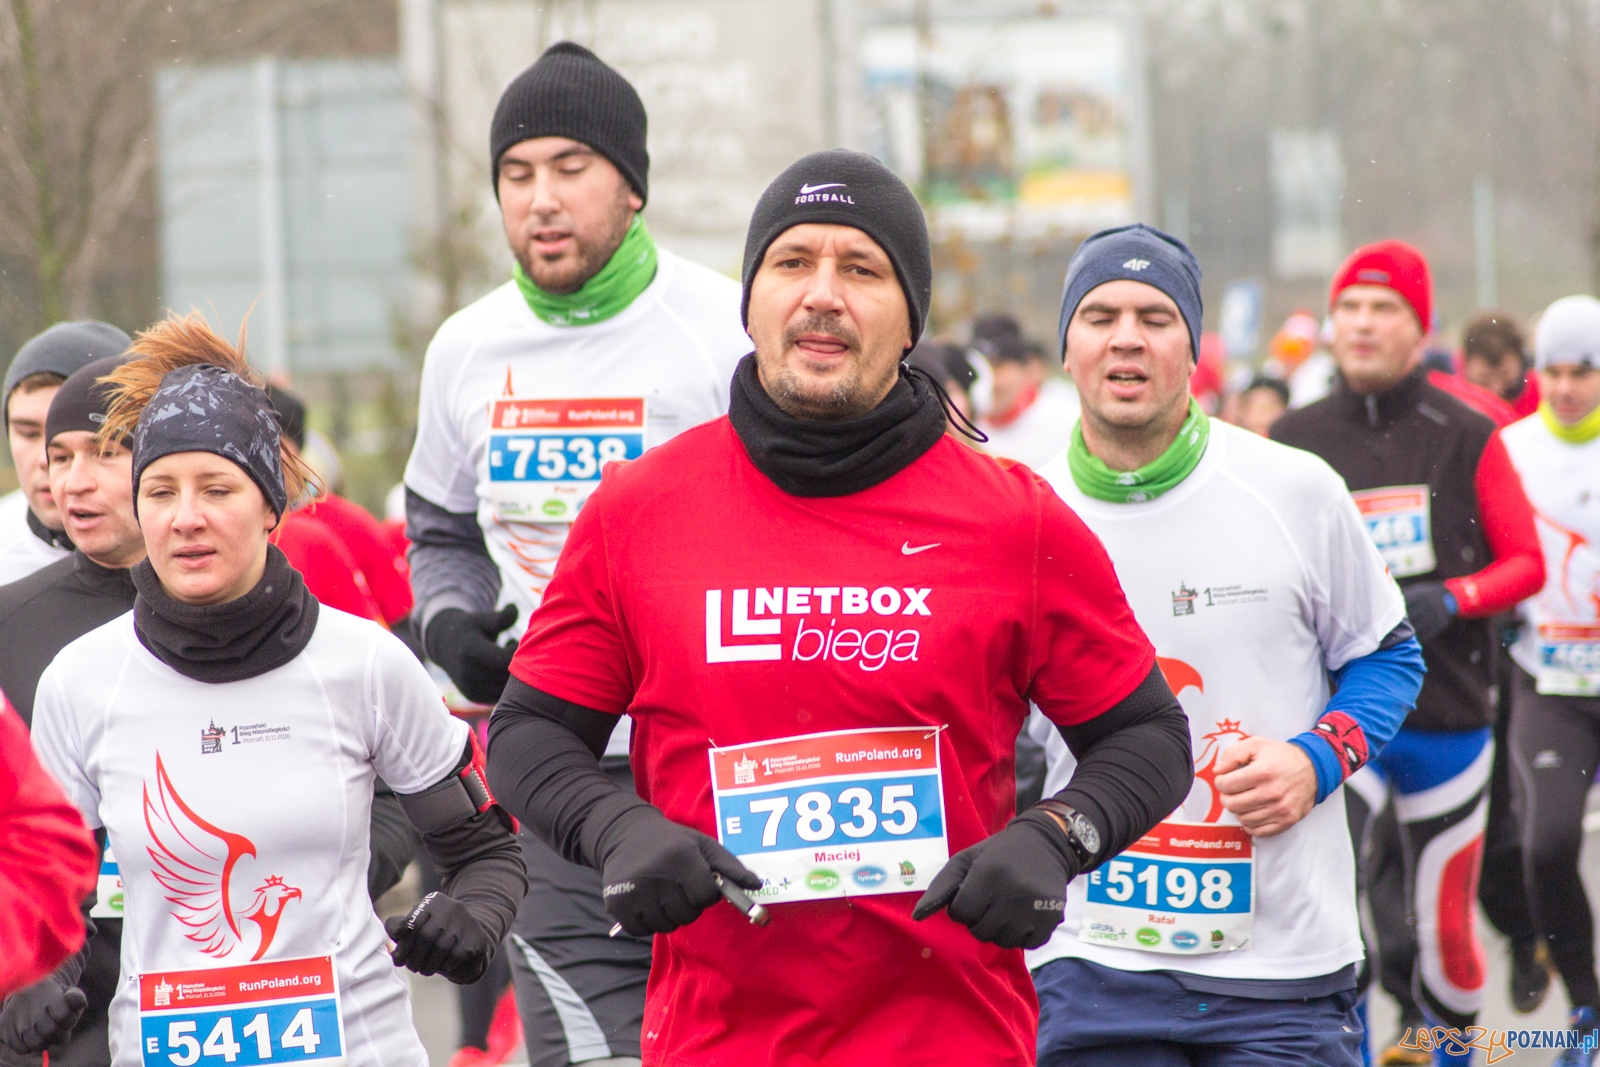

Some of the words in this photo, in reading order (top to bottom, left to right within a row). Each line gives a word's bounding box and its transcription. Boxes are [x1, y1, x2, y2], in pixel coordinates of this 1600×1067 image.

[795, 193, 855, 205] FOOTBALL
[1122, 258, 1151, 271] 4F
[507, 437, 627, 480] 7538
[754, 586, 932, 616] NETBOX
[1203, 586, 1215, 607] 1
[791, 618, 921, 672] biega
[239, 722, 267, 731] Poznański
[252, 725, 291, 736] Niepodległości
[230, 725, 241, 745] 1
[265, 732, 291, 742] 11.11.2016
[835, 747, 922, 763] RunPoland.org
[761, 757, 773, 776] 1
[726, 816, 742, 834] E
[749, 784, 918, 847] 7835
[1169, 837, 1242, 850] RunPoland.org
[814, 849, 861, 863] Maciej
[1090, 870, 1102, 885] E
[1105, 860, 1234, 910] 5198
[1090, 922, 1114, 932] GRUPA
[1148, 914, 1176, 925] Rafał
[1088, 931, 1119, 942] LUXMED
[239, 974, 322, 992] RunPoland.org
[176, 983, 185, 1000] 1
[146, 1037, 160, 1054] E
[167, 1007, 321, 1067] 5414
